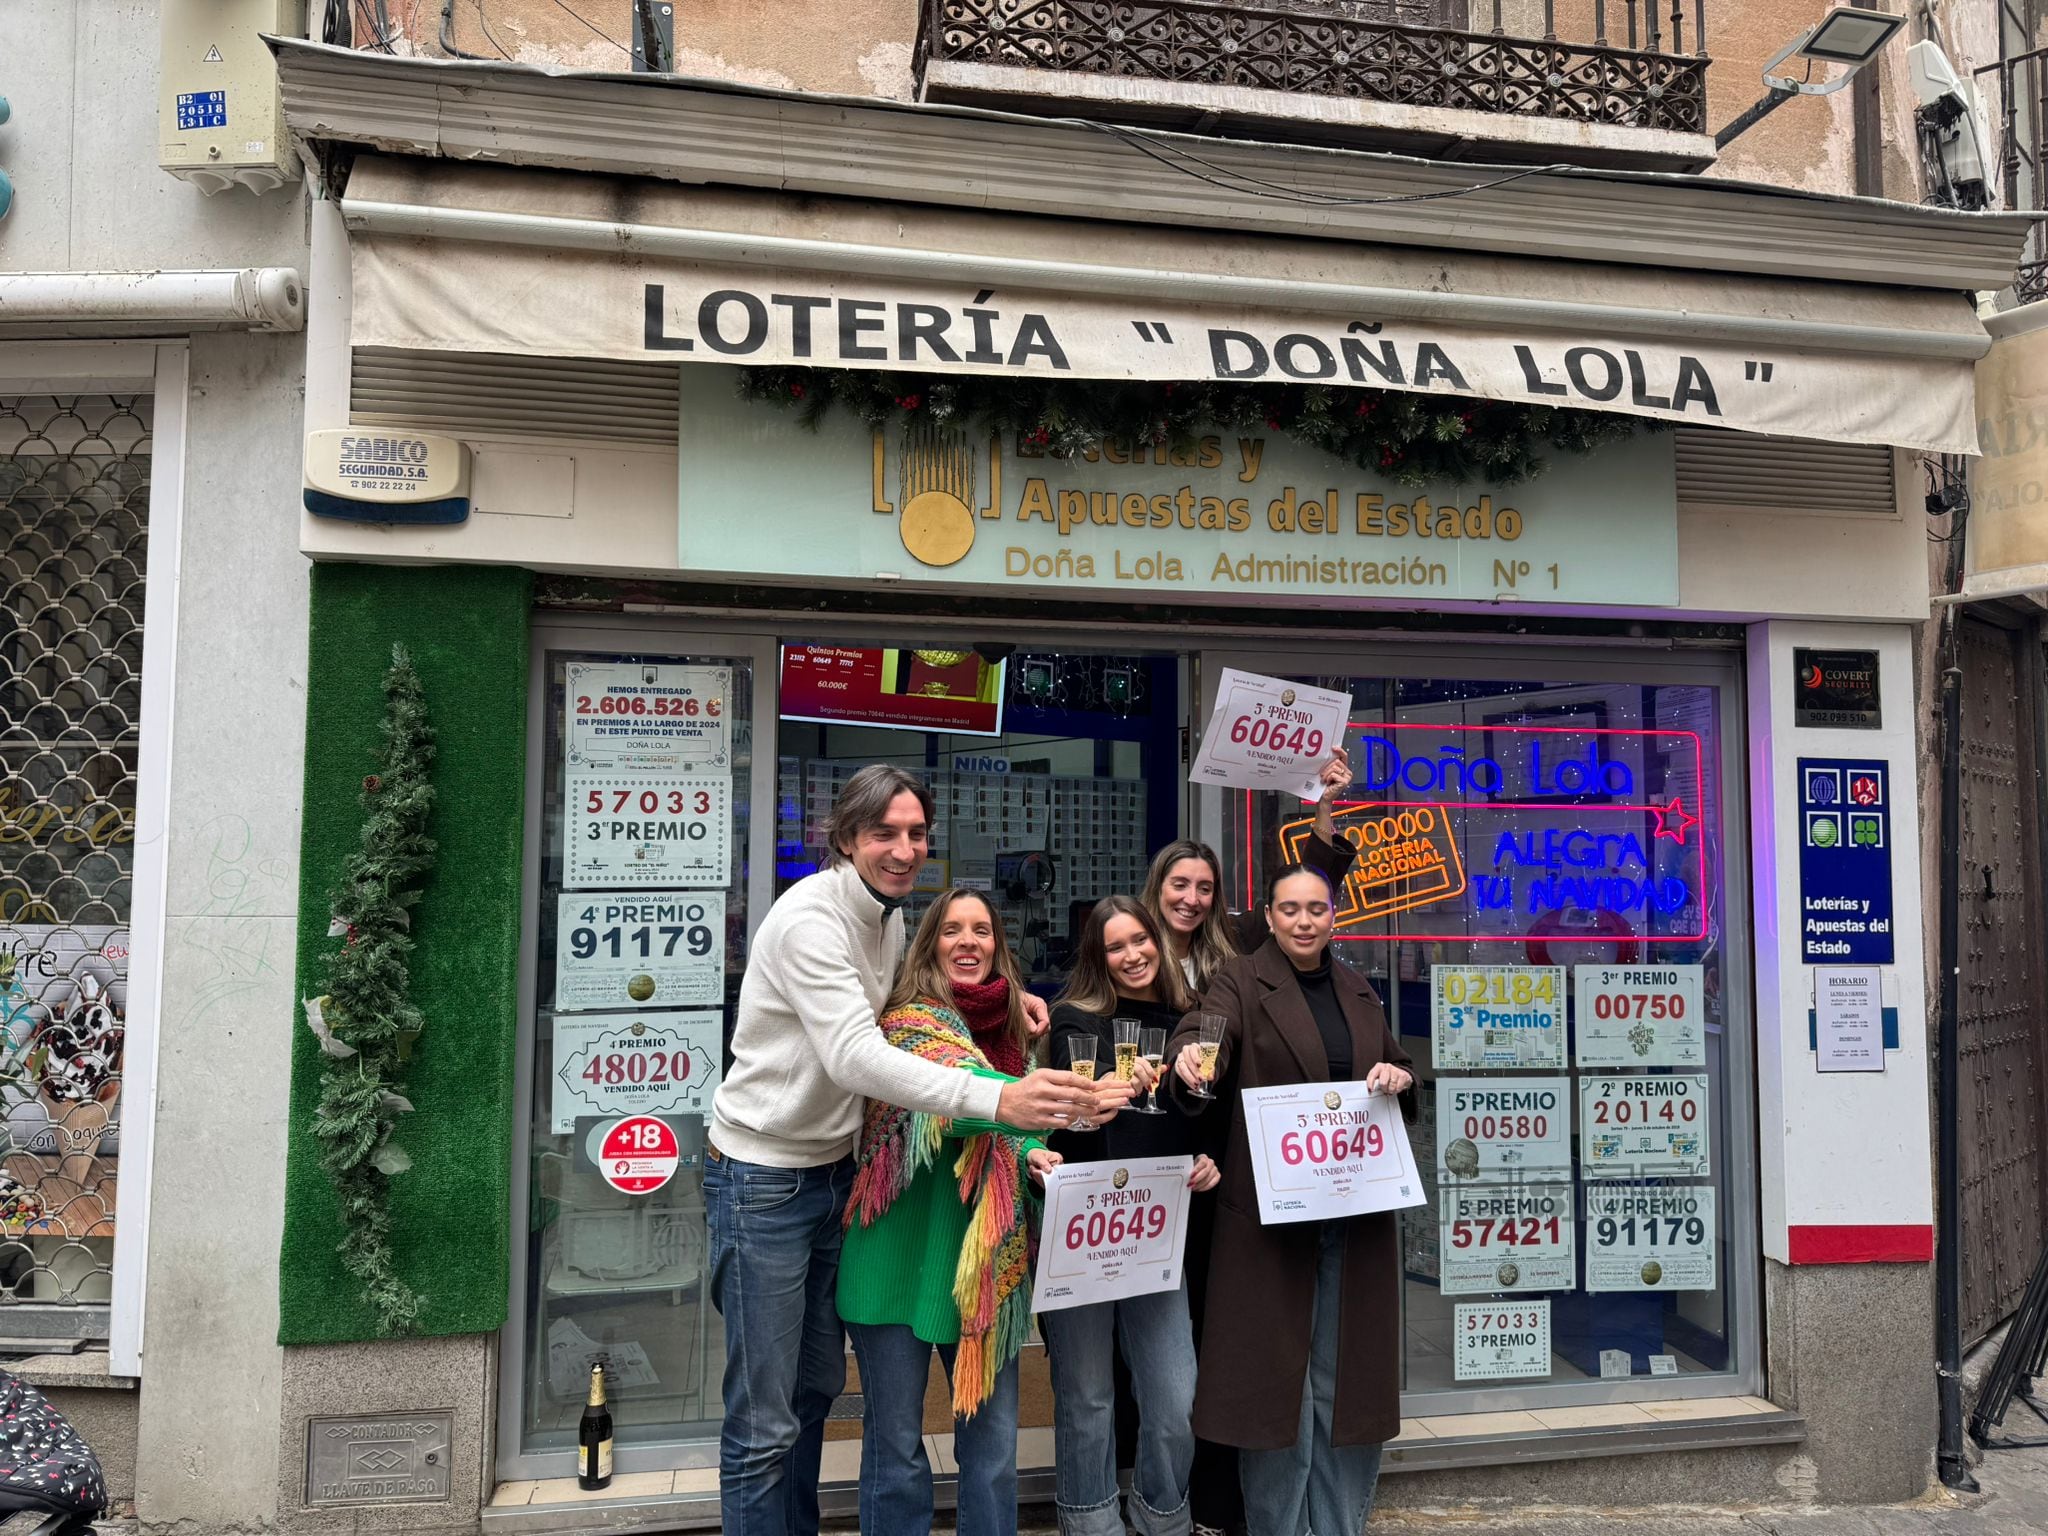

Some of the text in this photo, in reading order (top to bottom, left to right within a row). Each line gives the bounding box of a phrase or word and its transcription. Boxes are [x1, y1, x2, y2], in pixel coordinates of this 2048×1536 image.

[178, 95, 193, 105] B2
[643, 283, 1072, 370] LOTERÍA
[1207, 320, 1472, 389] DOÑA
[1513, 344, 1723, 417] LOLA
[341, 437, 428, 463] SABICO
[362, 481, 377, 489] 902
[393, 482, 403, 490] 22
[405, 483, 416, 491] 24
[1016, 477, 1522, 541] Apuestas del Estado
[1005, 547, 1560, 589] Doña Lola Administración Nº 1
[807, 645, 863, 659] Quintos Premios
[1825, 670, 1870, 681] COVERT
[1825, 681, 1871, 689] SECURITY
[607, 686, 692, 696] HEMOS ENTREGADO
[817, 680, 848, 691] 60.000€
[576, 695, 699, 716] 2.606.526
[577, 718, 589, 726] EN
[591, 718, 631, 727] PREMIOS
[654, 720, 683, 728] LARGO
[686, 720, 698, 728] DE
[699, 721, 720, 729] 2024
[609, 728, 630, 736] ESTE
[631, 728, 659, 736] PUNTO
[676, 729, 703, 737] VENTA
[626, 741, 671, 749] DOÑA LOLA
[1231, 715, 1323, 757] 60649
[954, 755, 1008, 772] NIÑO
[1361, 735, 1633, 796] Doña Lola
[586, 790, 711, 814] 57033
[610, 821, 707, 841] PREMIO
[1353, 849, 1446, 884] NACIONAL
[614, 896, 651, 904] VENDIDO
[1472, 874, 1688, 914] TU NAVIDAD
[605, 904, 705, 923] PREMIO
[1806, 896, 1870, 914] Loterías y
[1806, 918, 1889, 935] Apuestas del
[570, 925, 713, 959] 91179
[1806, 941, 1851, 954] Estado
[1602, 971, 1678, 985] 3er PREMIO
[1829, 977, 1868, 986] HORARIO
[1444, 975, 1555, 1005] 02184
[1595, 994, 1685, 1019] 00750
[1477, 1008, 1552, 1029] Premio
[619, 1038, 666, 1049] PREMIO
[582, 1050, 691, 1084] 48020
[604, 1082, 670, 1093] VENDIDO AQUÍ
[1601, 1081, 1687, 1097] 2º PREMIO
[1472, 1091, 1556, 1111] PREMIO
[1314, 1110, 1369, 1127] PREMIO
[1593, 1099, 1697, 1124] 20140
[618, 1124, 661, 1149] +18
[1464, 1115, 1547, 1139] 00580
[1281, 1124, 1384, 1165] 60649
[1101, 1188, 1151, 1208] PREMIO
[1477, 1197, 1555, 1216] PREMIO
[1623, 1198, 1698, 1214] PREMIO
[1065, 1205, 1167, 1250] 60649
[1452, 1216, 1559, 1248] 57421
[1597, 1217, 1704, 1246] 91179
[1467, 1312, 1538, 1330] 57033
[1481, 1333, 1536, 1348] PREMIO
[351, 1423, 414, 1440] CONTADOR
[322, 1482, 370, 1498] LLAVE
[375, 1480, 394, 1496] DE
